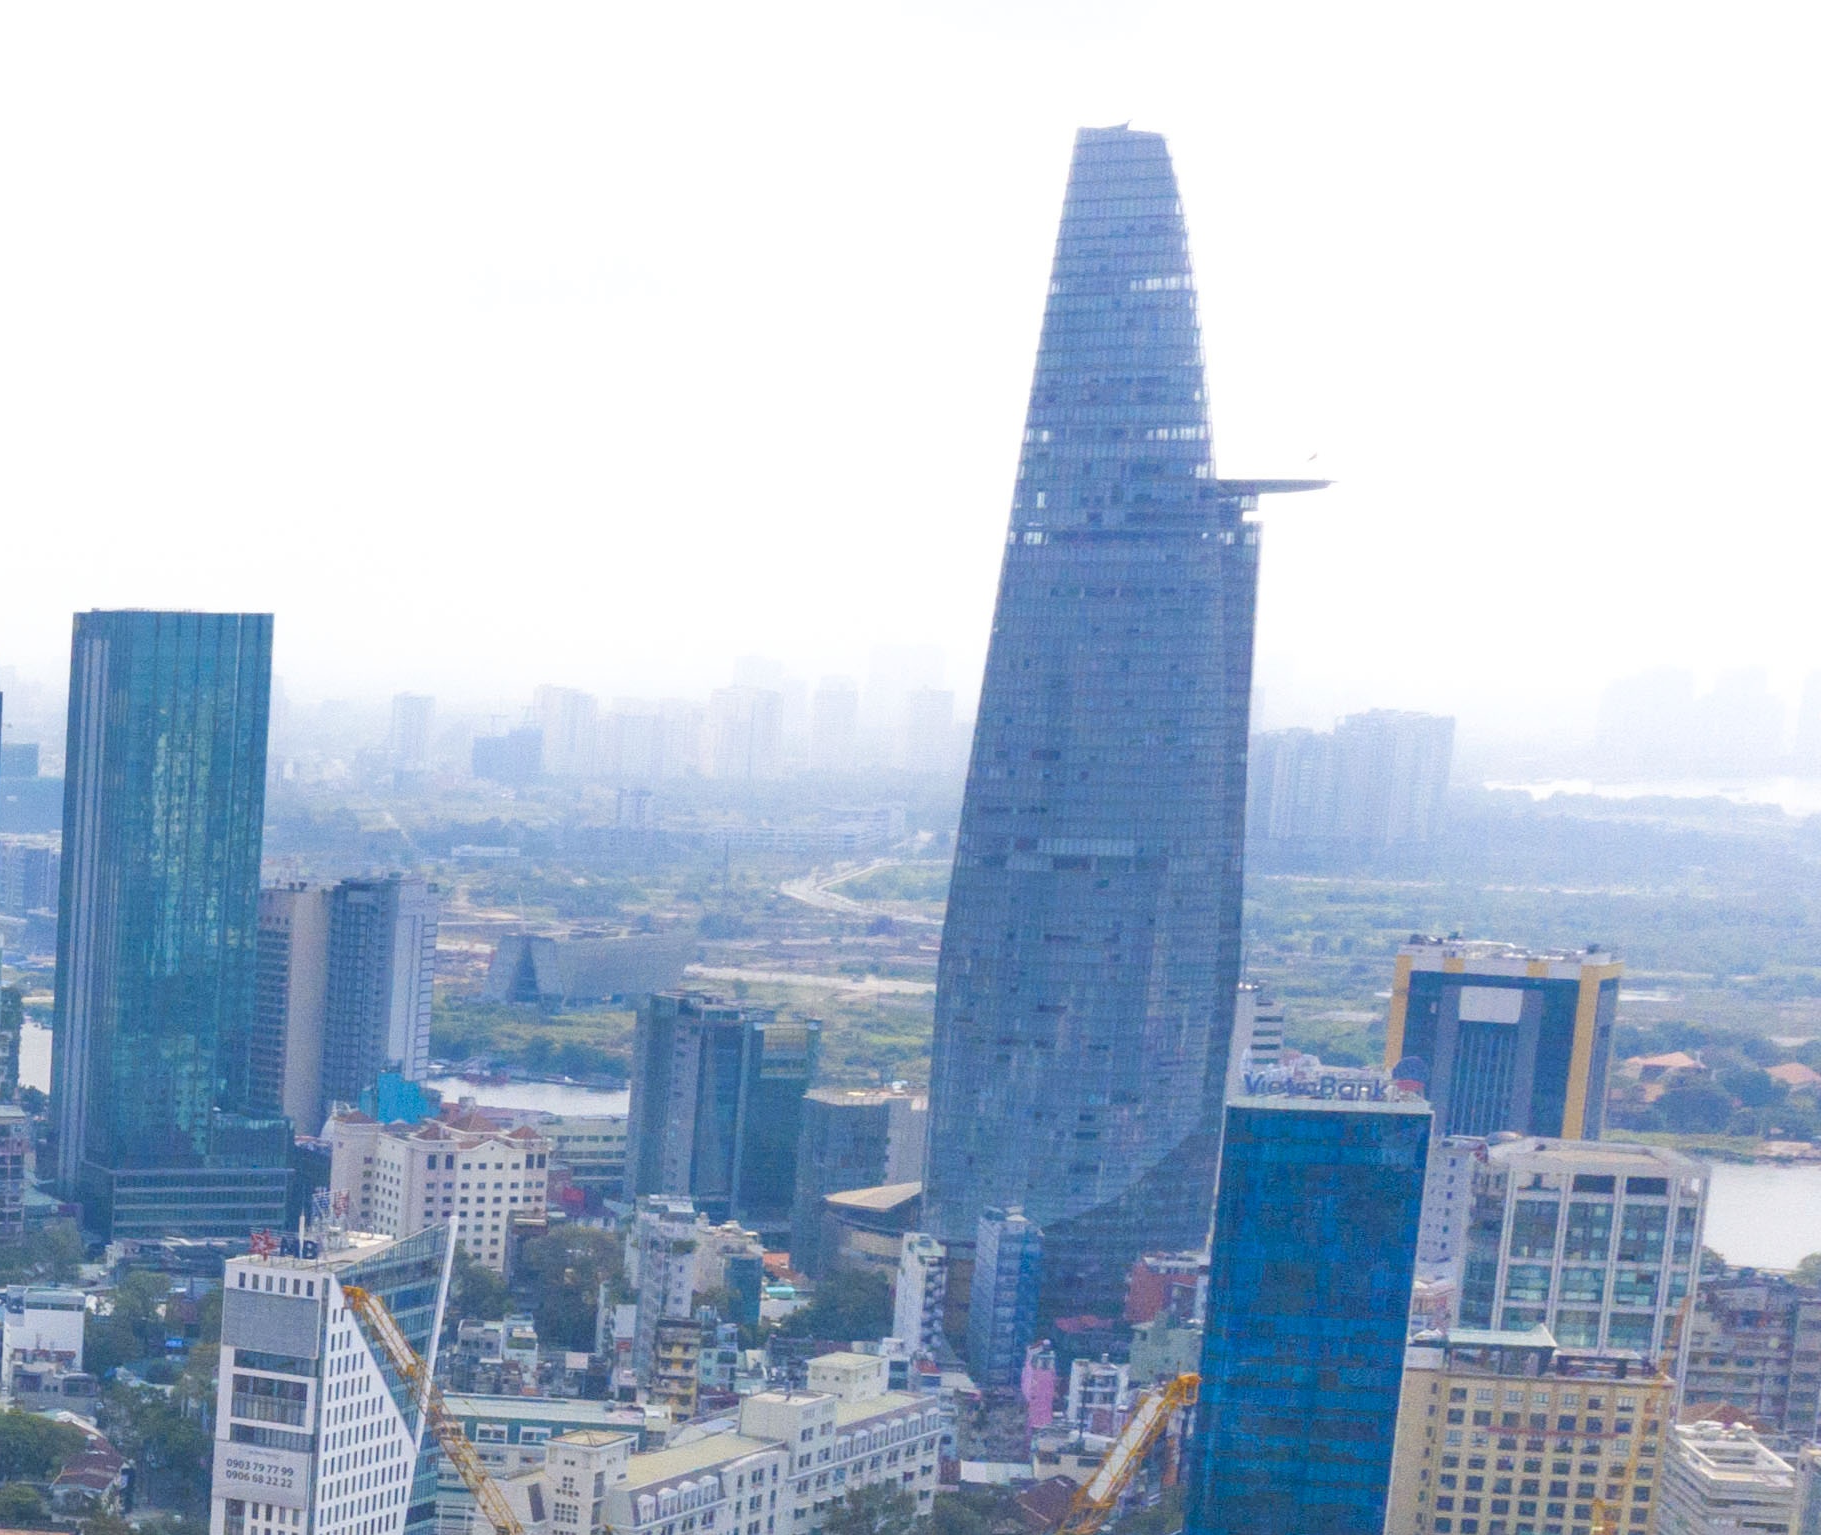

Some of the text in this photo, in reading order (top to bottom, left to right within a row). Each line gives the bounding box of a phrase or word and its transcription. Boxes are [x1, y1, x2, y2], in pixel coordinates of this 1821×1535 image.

[1243, 1071, 1388, 1101] VietinBank
[226, 1458, 294, 1477] 0903 79 77 99
[225, 1469, 251, 1481] 0906
[266, 1476, 278, 1486] 22
[280, 1478, 293, 1489] 22
